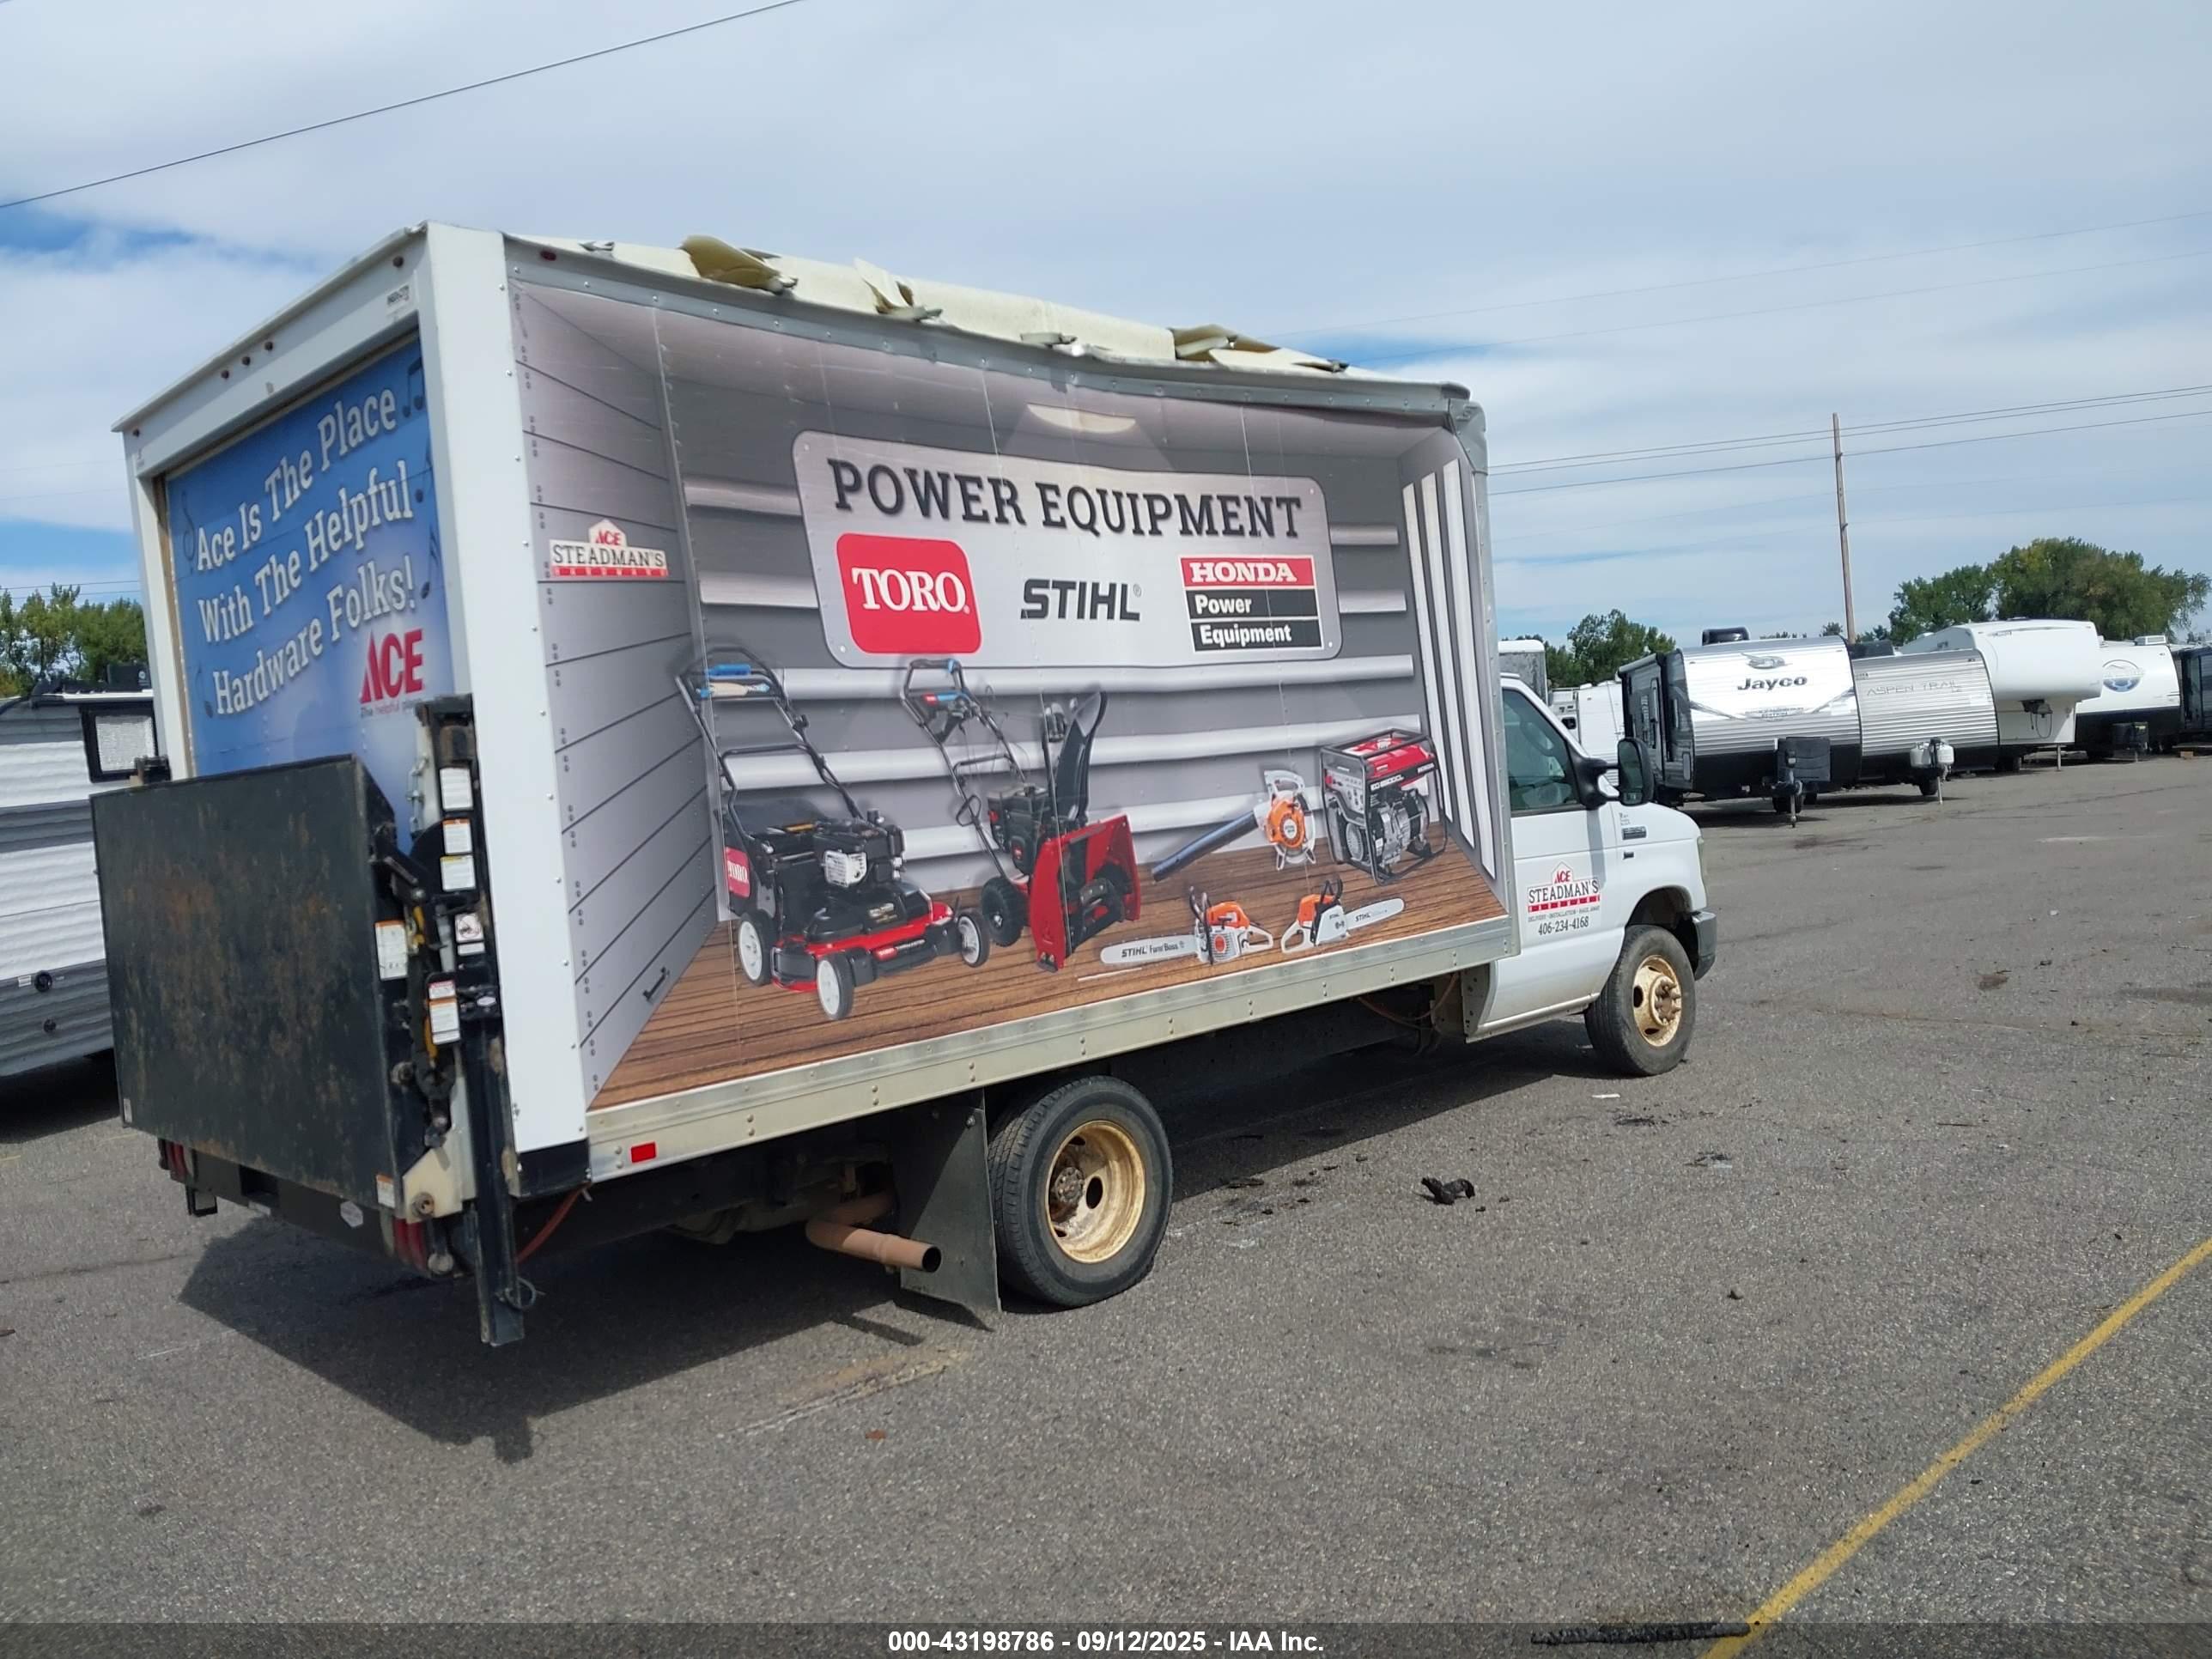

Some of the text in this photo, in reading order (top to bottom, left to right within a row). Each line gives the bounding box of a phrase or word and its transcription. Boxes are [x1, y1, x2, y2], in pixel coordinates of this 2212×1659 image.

[198, 389, 397, 570] Ace Is The Place
[827, 458, 1302, 539] POWER EQUIPMENT
[595, 530, 621, 546] ACE
[198, 459, 413, 642] With The Helpful
[553, 544, 665, 568] STEADMAN'S
[1189, 562, 1297, 583] HONDA
[1194, 594, 1252, 615] Power
[213, 555, 416, 714] Hardware Folks!
[1200, 623, 1292, 648] Equipment
[359, 629, 423, 705] ACE
[1736, 676, 1808, 691] Jayco
[1867, 679, 1960, 696] ASPEN TRAIL
[727, 861, 747, 882] TORO
[1554, 870, 1571, 884] ACE
[1528, 879, 1599, 904] STEADMAN'S
[1538, 915, 1589, 936] 406-234-4168
[1121, 947, 1147, 958] STIHL
